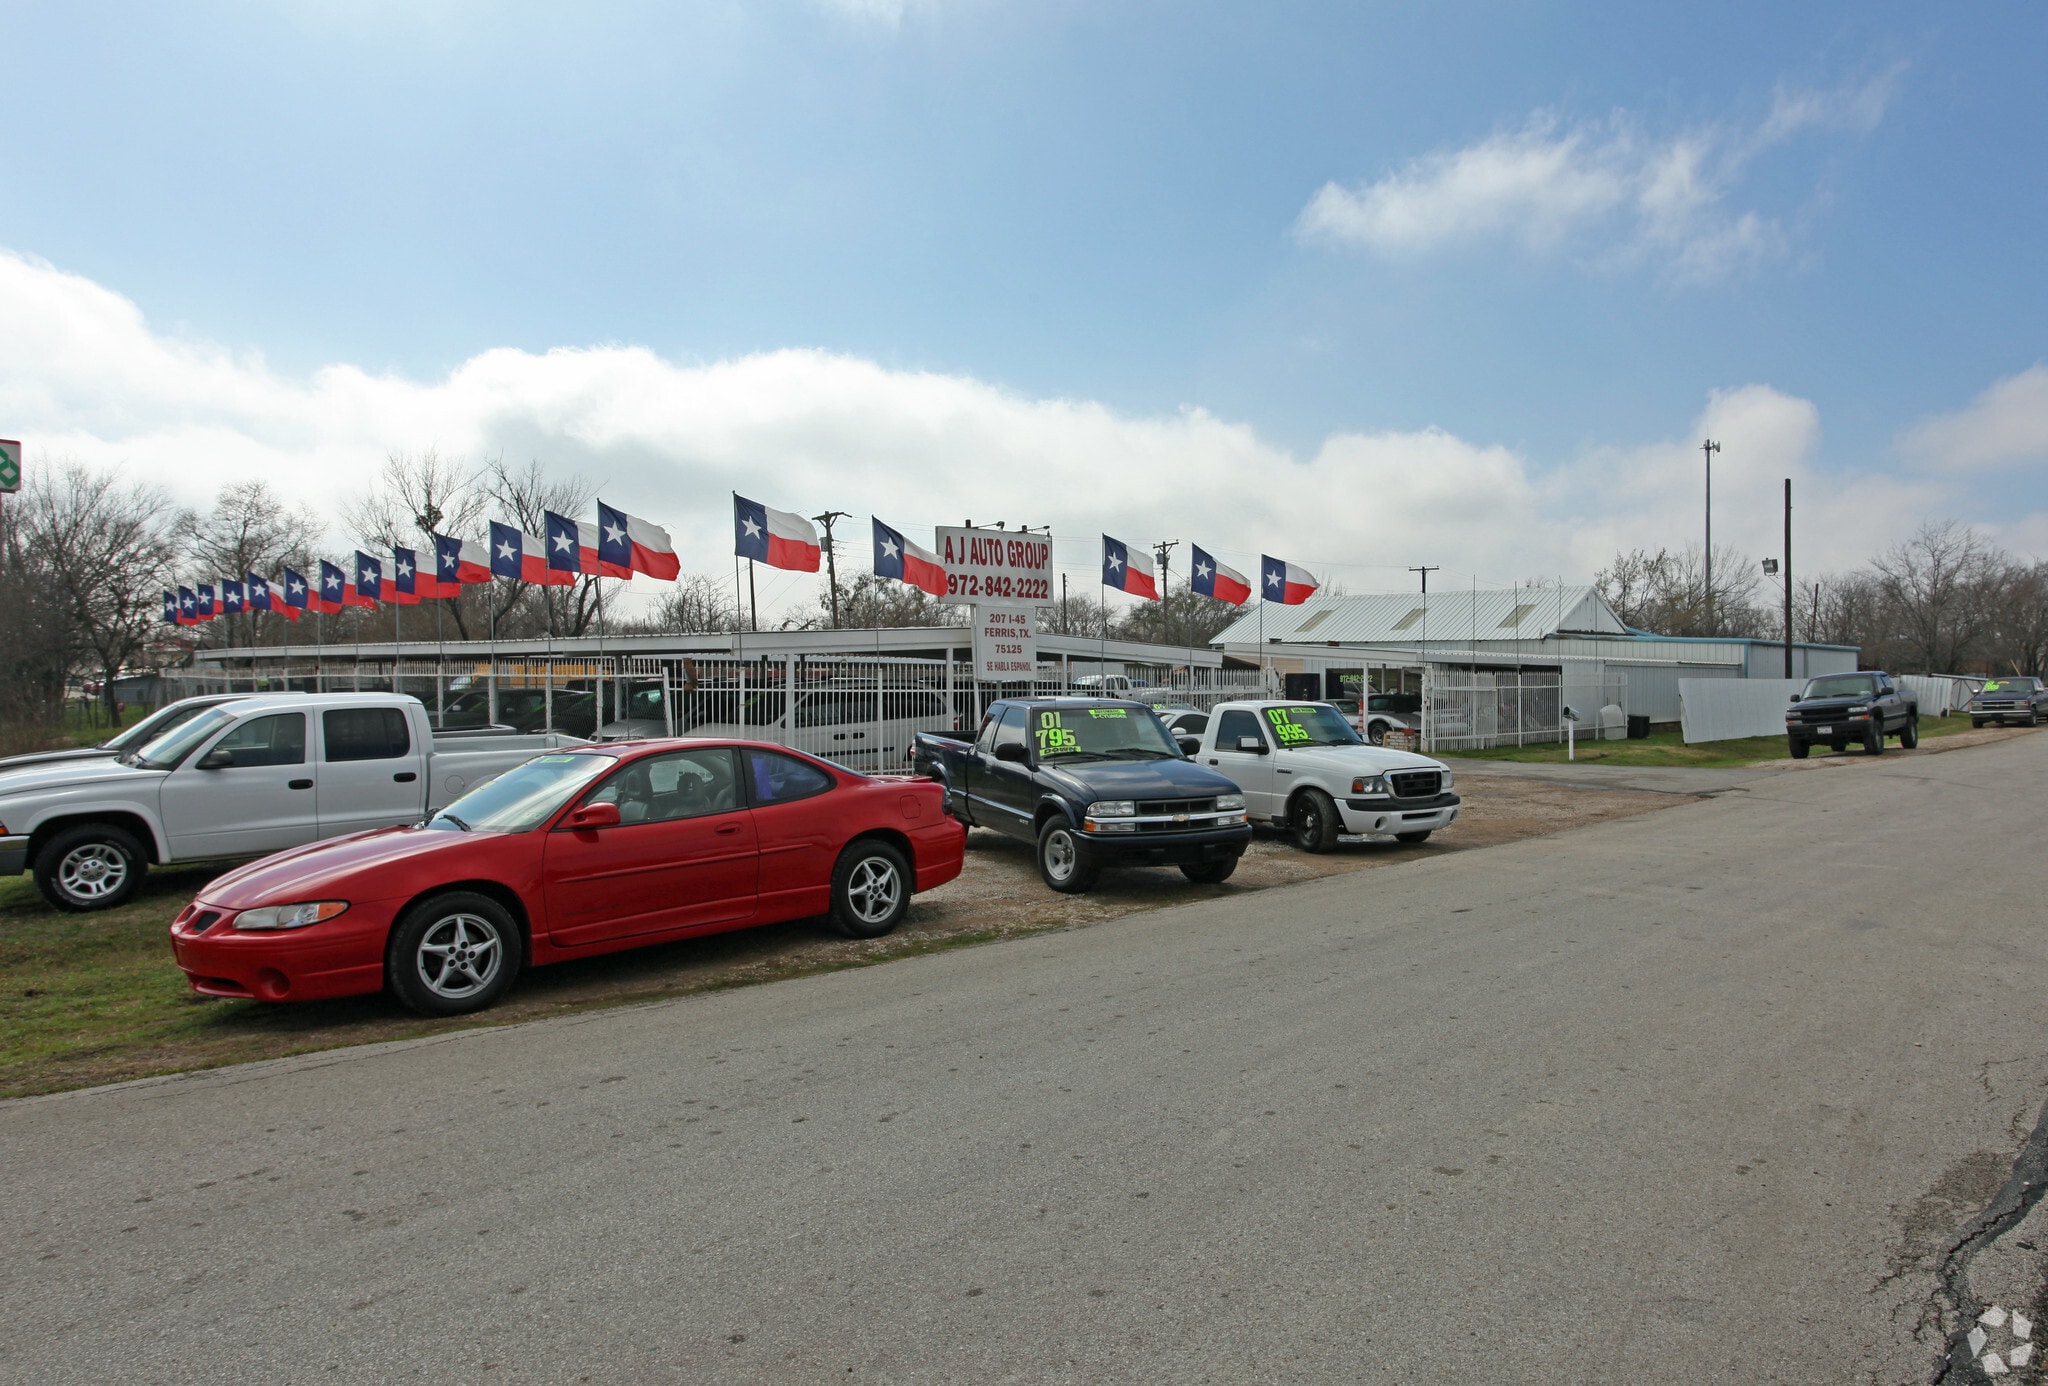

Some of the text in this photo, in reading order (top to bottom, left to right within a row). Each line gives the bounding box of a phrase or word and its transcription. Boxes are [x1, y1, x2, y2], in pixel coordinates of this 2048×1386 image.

[945, 535, 1048, 570] A J AUTO GROUP
[948, 574, 1048, 599] 972-842-2222
[990, 614, 1026, 624] 207 I-45
[995, 644, 1022, 654] 75125
[986, 661, 993, 671] SE
[994, 661, 1010, 671] HABLA
[1040, 711, 1062, 729] 01
[1267, 709, 1290, 725] 07
[1035, 728, 1076, 748] 795
[1275, 723, 1309, 741] 995
